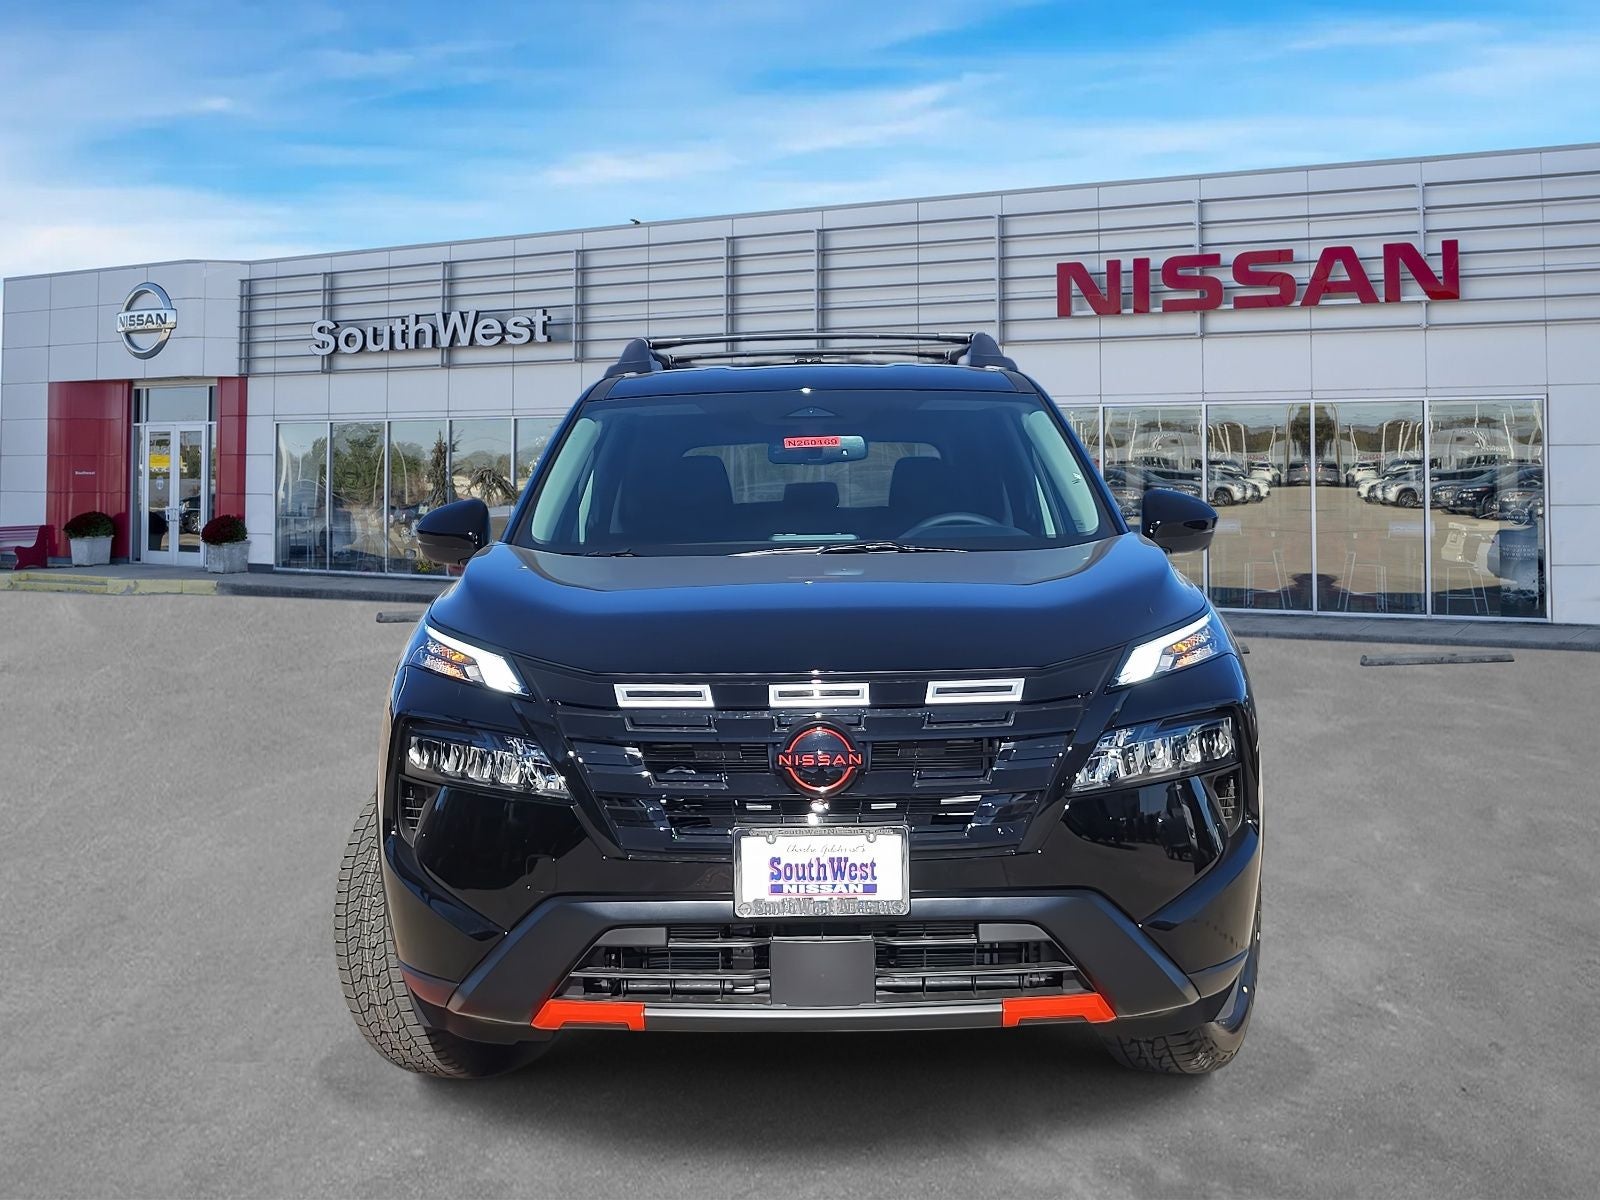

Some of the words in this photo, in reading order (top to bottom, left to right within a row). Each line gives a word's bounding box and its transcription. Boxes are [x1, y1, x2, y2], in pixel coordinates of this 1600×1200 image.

[1056, 239, 1461, 317] NISSAN
[119, 312, 168, 328] NISSAN
[309, 308, 551, 356] SouthWest
[778, 753, 862, 767] NISSAN
[768, 856, 878, 882] SouthWest
[782, 883, 864, 894] NISSAN
